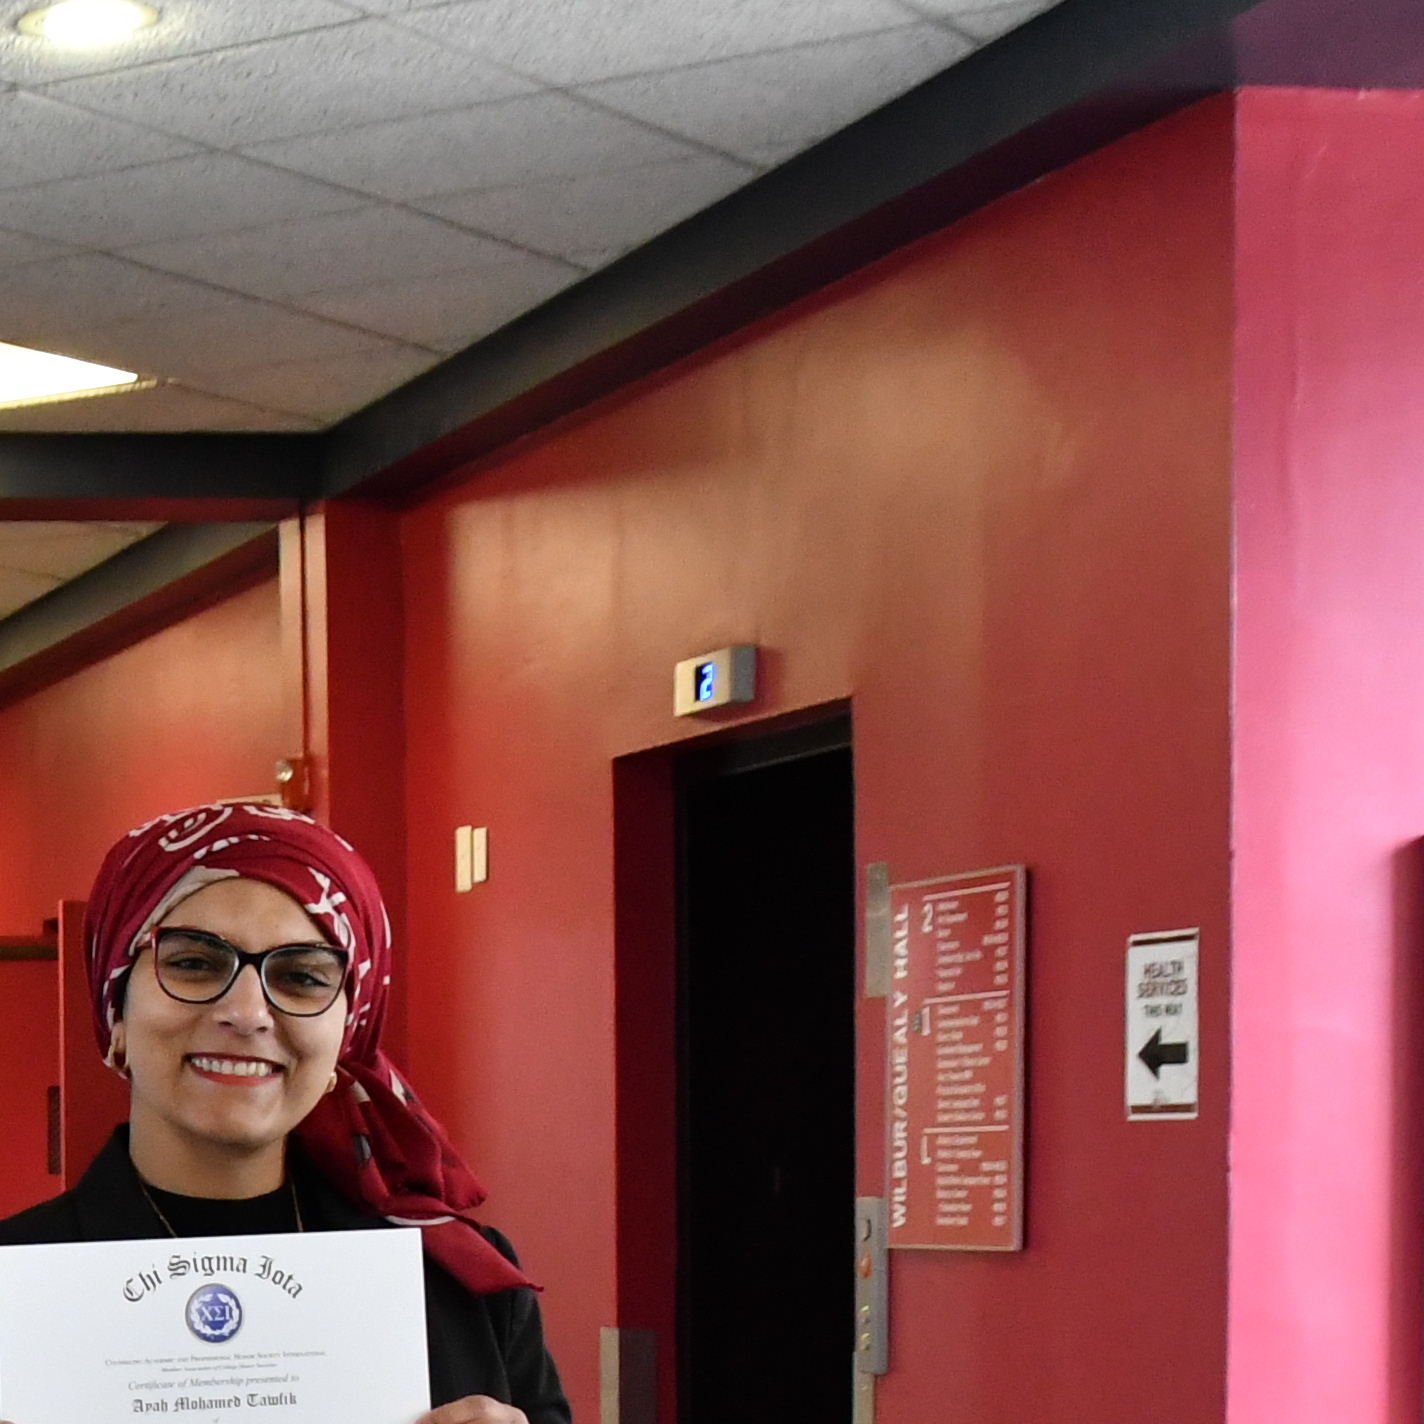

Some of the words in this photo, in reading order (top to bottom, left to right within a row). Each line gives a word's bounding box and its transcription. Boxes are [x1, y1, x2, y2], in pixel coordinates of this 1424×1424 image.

[921, 902, 934, 934] 2
[894, 903, 909, 980] HALL
[123, 1264, 162, 1302] Chi
[167, 1251, 247, 1279] Sigma
[255, 1255, 303, 1299] Iota
[173, 1395, 241, 1412] Mohamed
